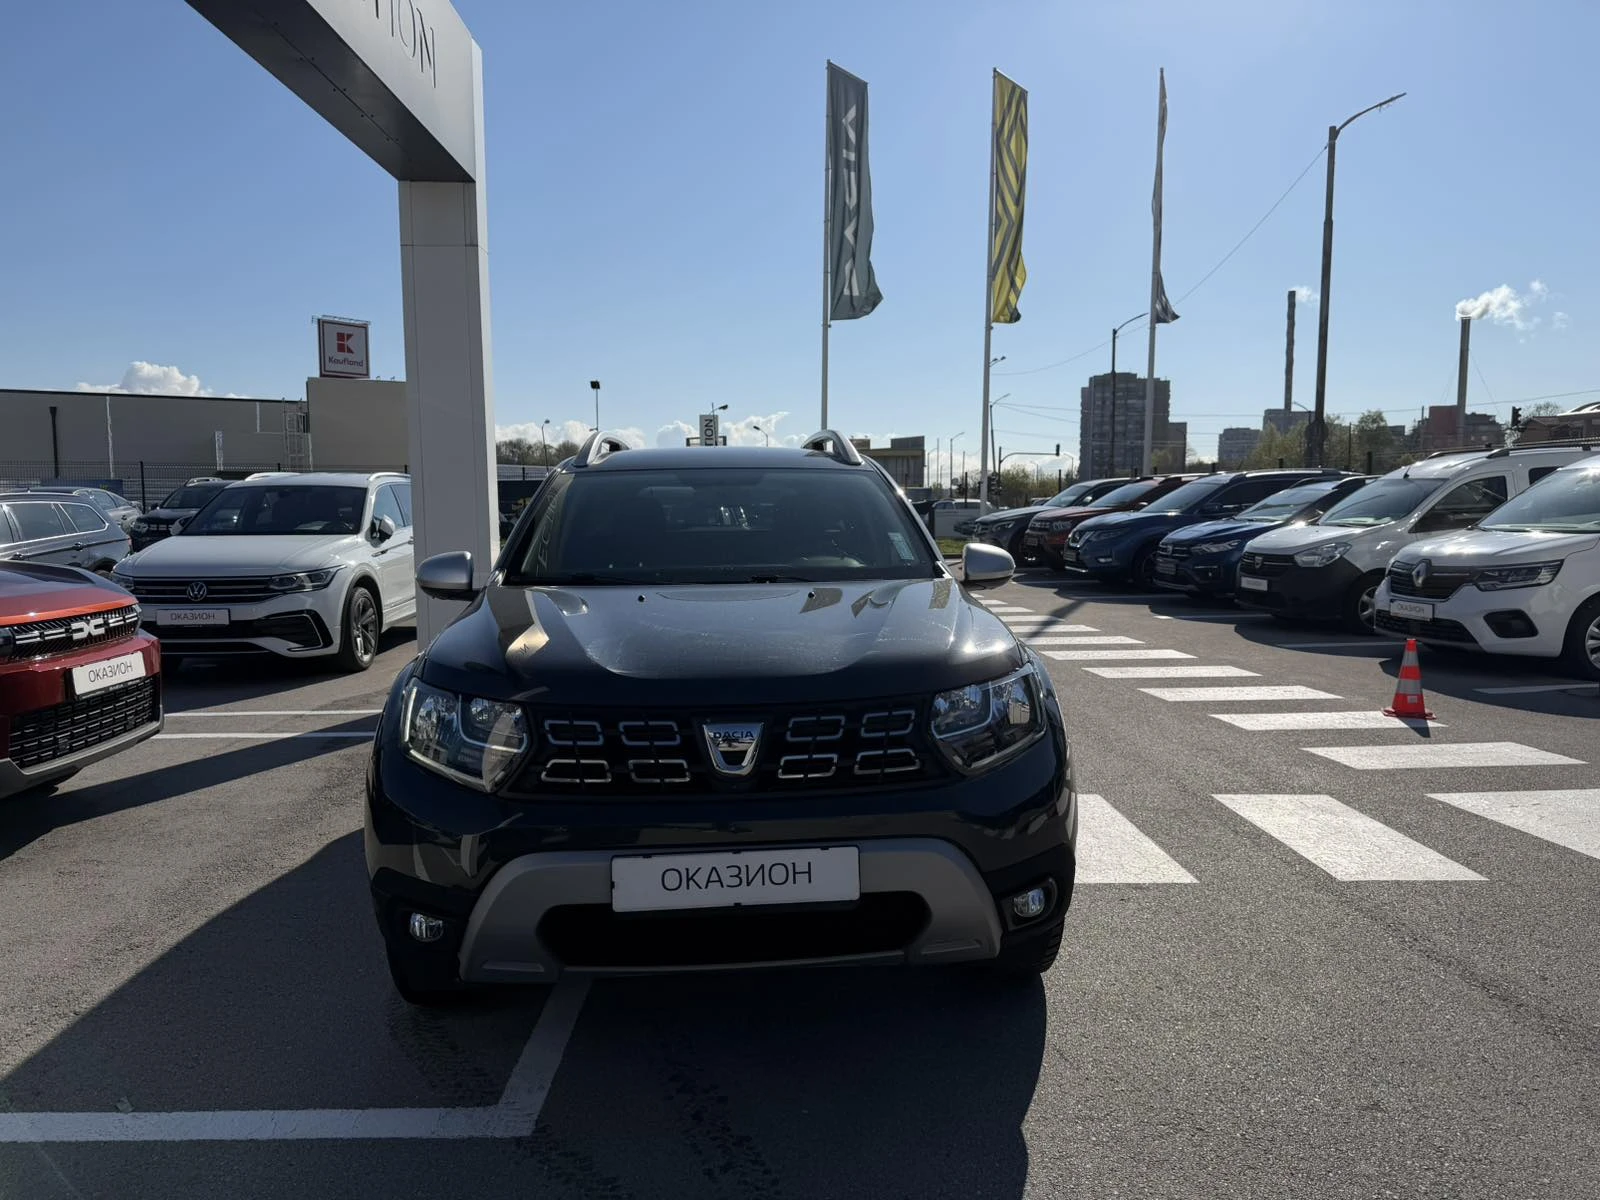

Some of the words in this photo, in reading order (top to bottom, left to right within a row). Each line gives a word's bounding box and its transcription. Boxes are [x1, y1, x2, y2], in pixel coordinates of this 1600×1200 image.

[328, 356, 364, 367] Kaufland
[170, 612, 215, 621] ОКАЗИОН
[88, 660, 134, 683] ОКАЗИОН
[713, 730, 754, 739] DACIA
[661, 861, 812, 891] ОКАЗИОН
